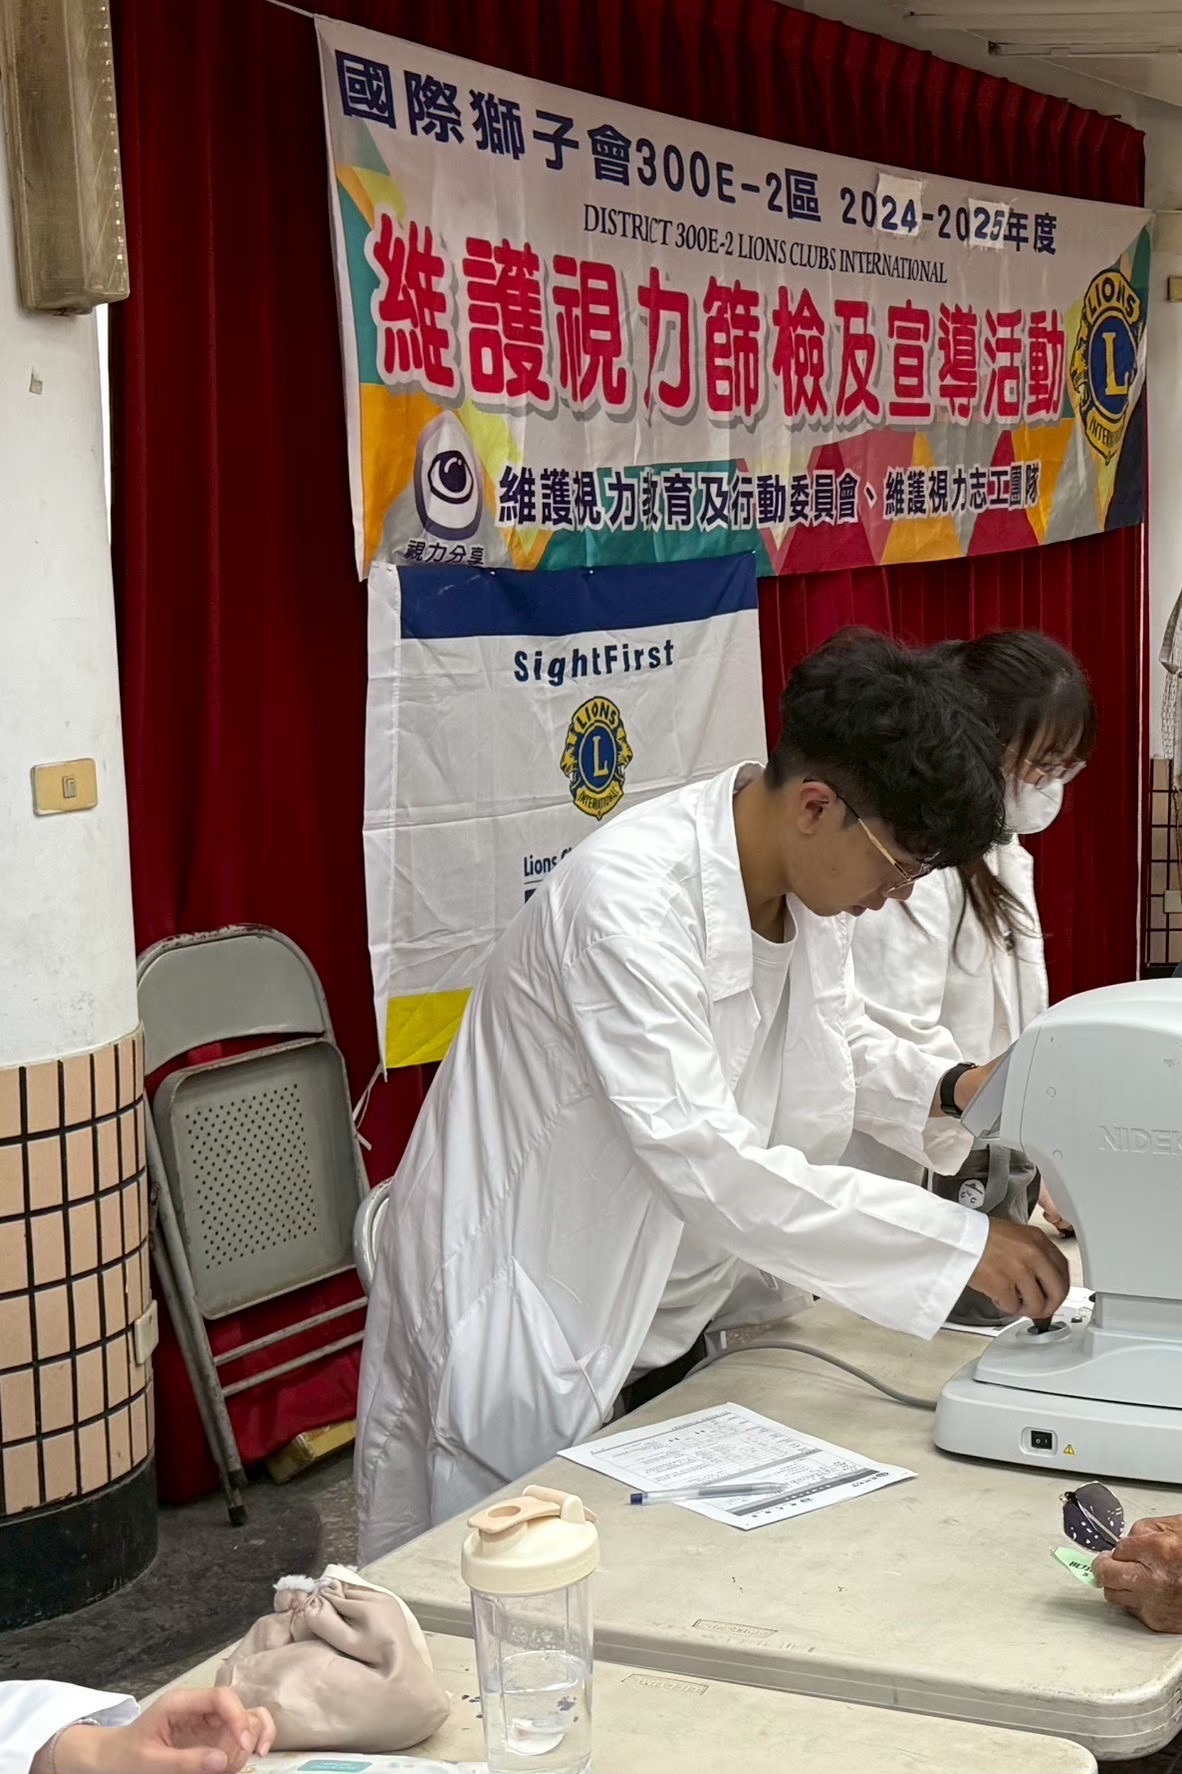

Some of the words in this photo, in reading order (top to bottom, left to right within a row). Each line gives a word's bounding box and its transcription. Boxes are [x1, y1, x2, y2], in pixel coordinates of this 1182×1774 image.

[335, 49, 821, 222] 國際獅子會300E-2區
[583, 204, 673, 246] DISTRICT
[675, 222, 734, 256] 300E-2
[738, 233, 787, 264] LIONS
[789, 242, 836, 271] CLUBS
[840, 249, 948, 284] INTERNATIONAL
[1086, 277, 1137, 318] LIONS
[1102, 331, 1129, 396] L
[404, 540, 484, 565] 視力分享
[514, 640, 674, 687] SightFirst
[576, 701, 617, 729] LIONS
[592, 735, 609, 777] L
